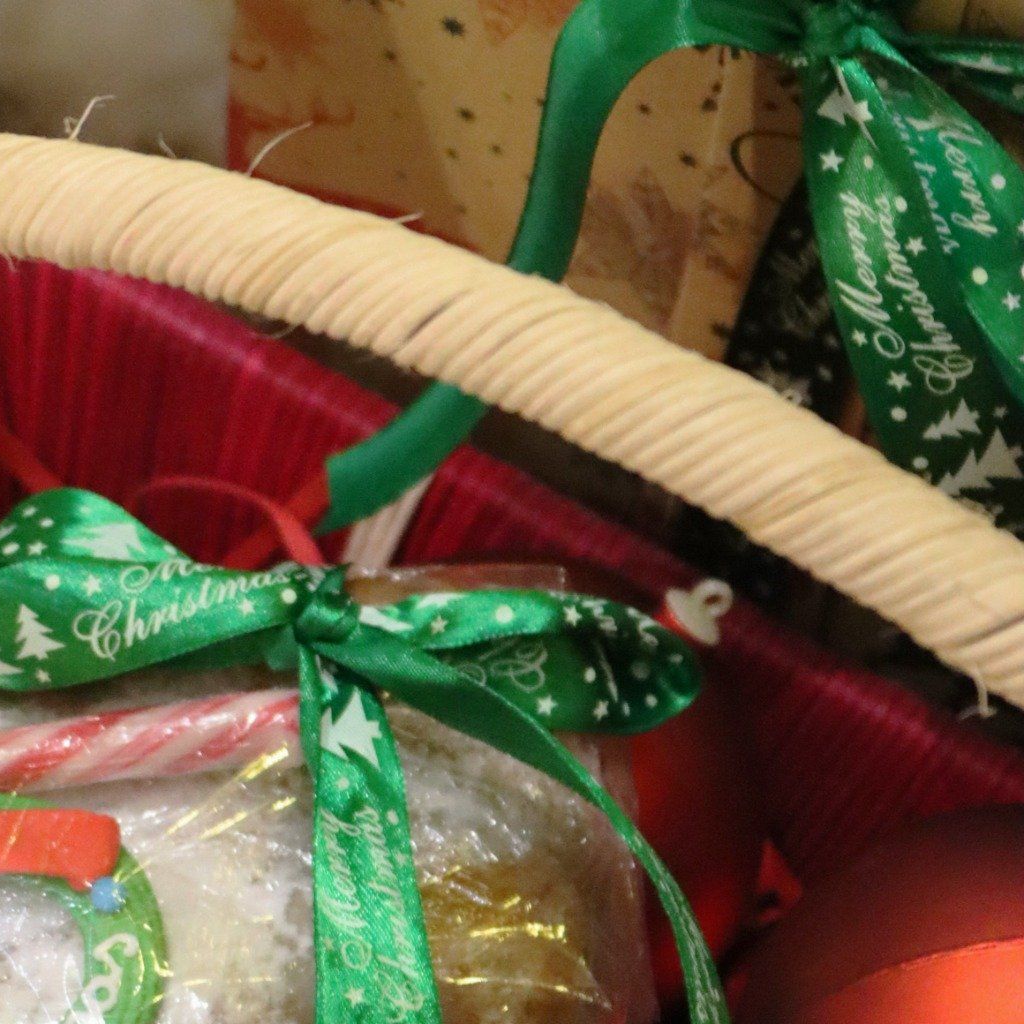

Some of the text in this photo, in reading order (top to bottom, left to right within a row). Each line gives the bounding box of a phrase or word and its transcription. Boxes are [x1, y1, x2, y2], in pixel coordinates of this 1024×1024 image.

[835, 190, 905, 359] Merry
[875, 197, 974, 395] Christmas
[317, 807, 373, 970] Merry
